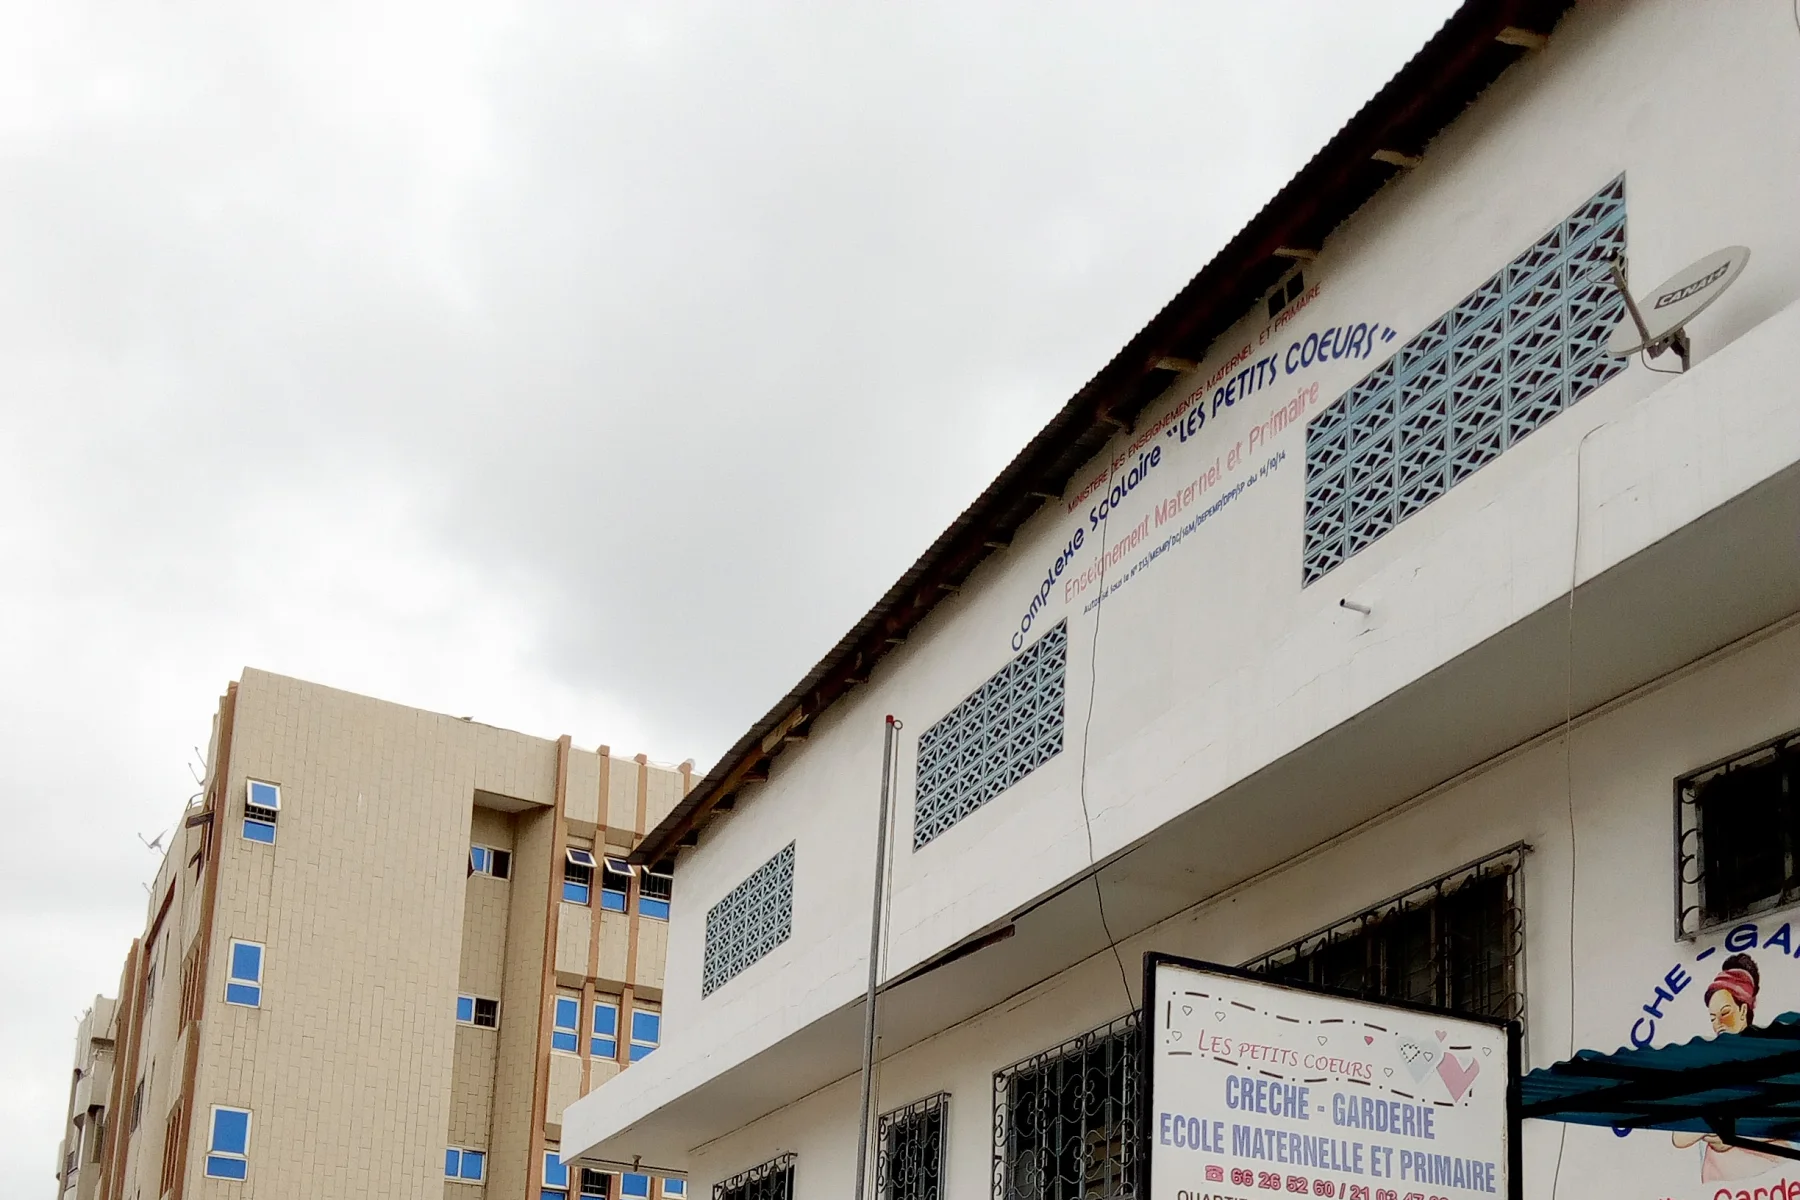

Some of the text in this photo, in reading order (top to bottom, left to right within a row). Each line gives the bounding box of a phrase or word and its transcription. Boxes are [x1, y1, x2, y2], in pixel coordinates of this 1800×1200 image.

[1110, 453, 1126, 473] DES
[1128, 386, 1203, 459] ENSEIGNEMENTS
[1206, 342, 1255, 392] MATERNEL
[1259, 325, 1271, 346] ET
[1274, 280, 1322, 333] PRIMAIRE
[1212, 353, 1279, 418] PETITS
[1064, 380, 1320, 605] Enseignement Maternel et Primaire
[1246, 473, 1258, 487] du
[1198, 1029, 1373, 1080] LES PETITS COEURS
[1225, 1074, 1310, 1121] CRECHE
[1332, 1092, 1436, 1140] GARDERIE
[1159, 1112, 1497, 1194] ECOLE MATERNELLE ET PRIMAIRE
[1231, 1168, 1254, 1187] 66
[1258, 1172, 1281, 1190] 26
[1286, 1176, 1308, 1194] 52
[1313, 1180, 1335, 1198] 60
